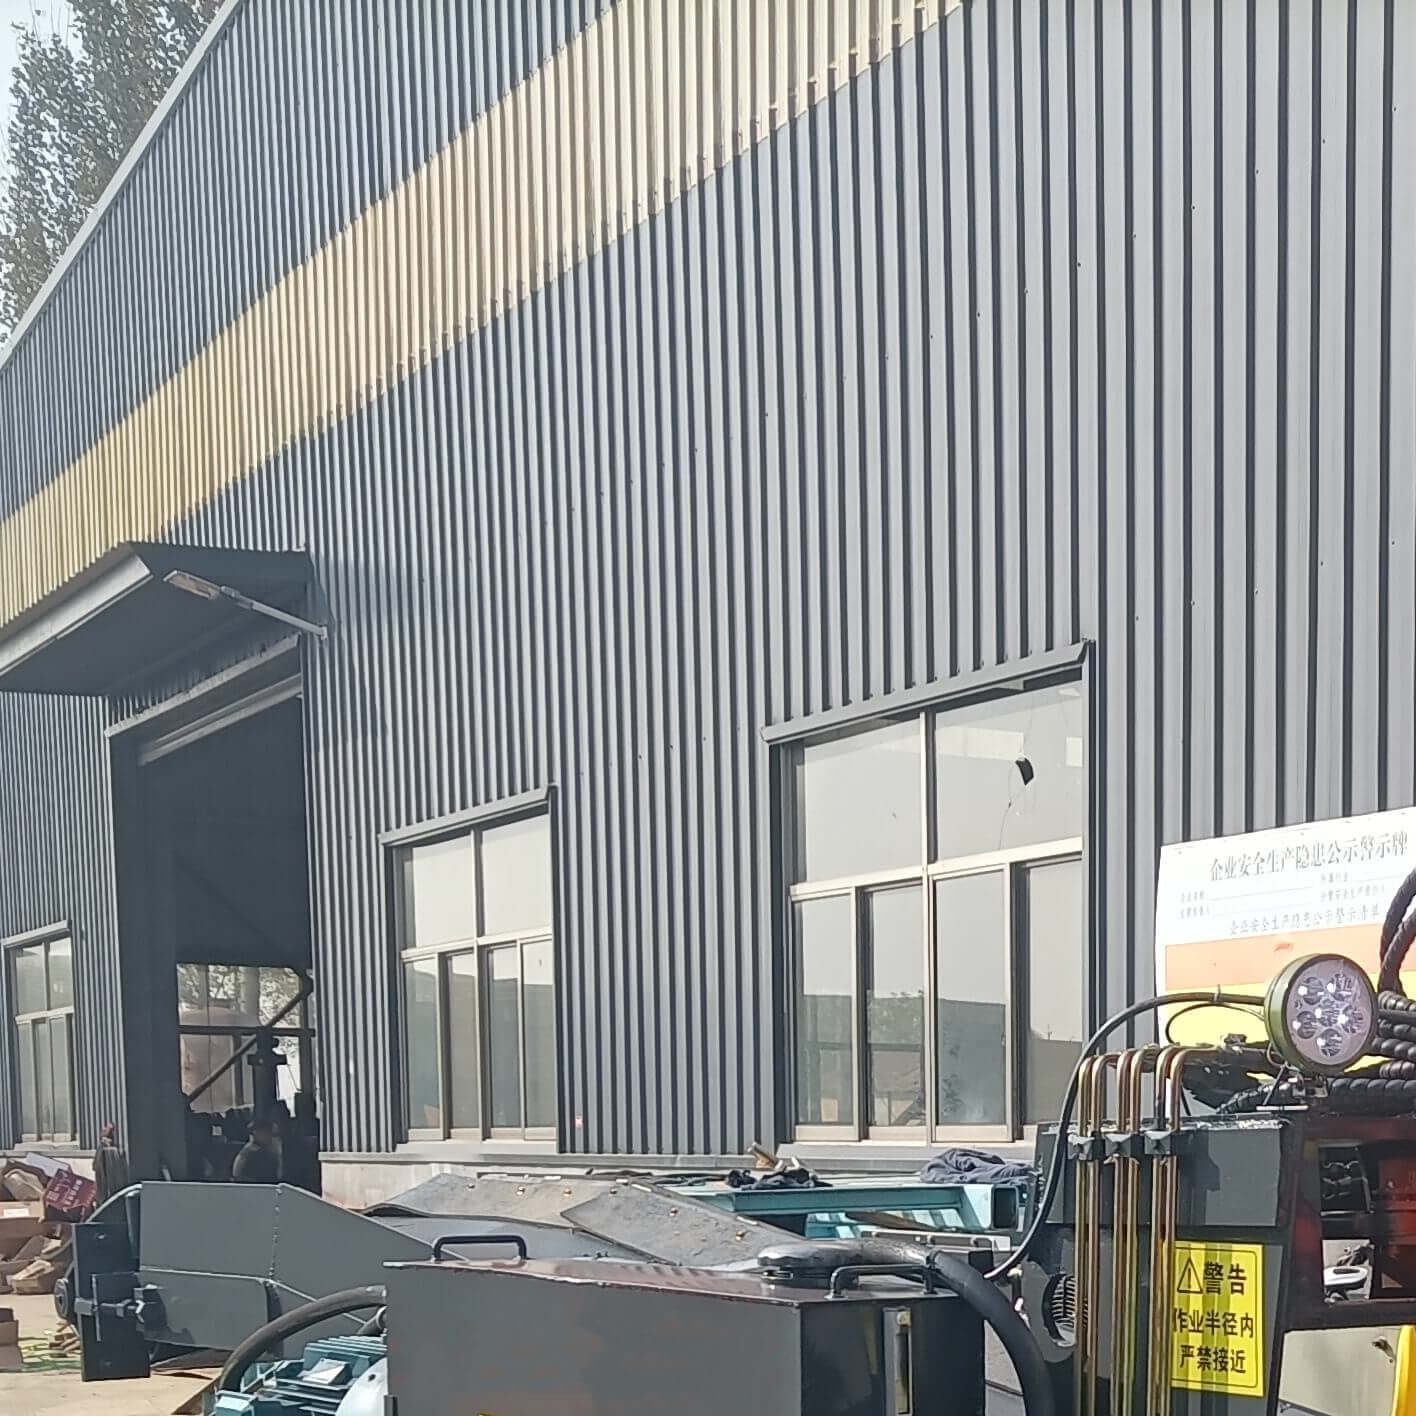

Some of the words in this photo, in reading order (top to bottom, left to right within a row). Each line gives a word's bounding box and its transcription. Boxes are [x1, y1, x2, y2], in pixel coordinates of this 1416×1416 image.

[1210, 831, 1408, 881] 企业安全生产隐患公示警示牌
[1203, 1261, 1247, 1295] 警告
[1173, 1308, 1254, 1339] 作业半径内
[1179, 1344, 1246, 1374] 严禁接近
